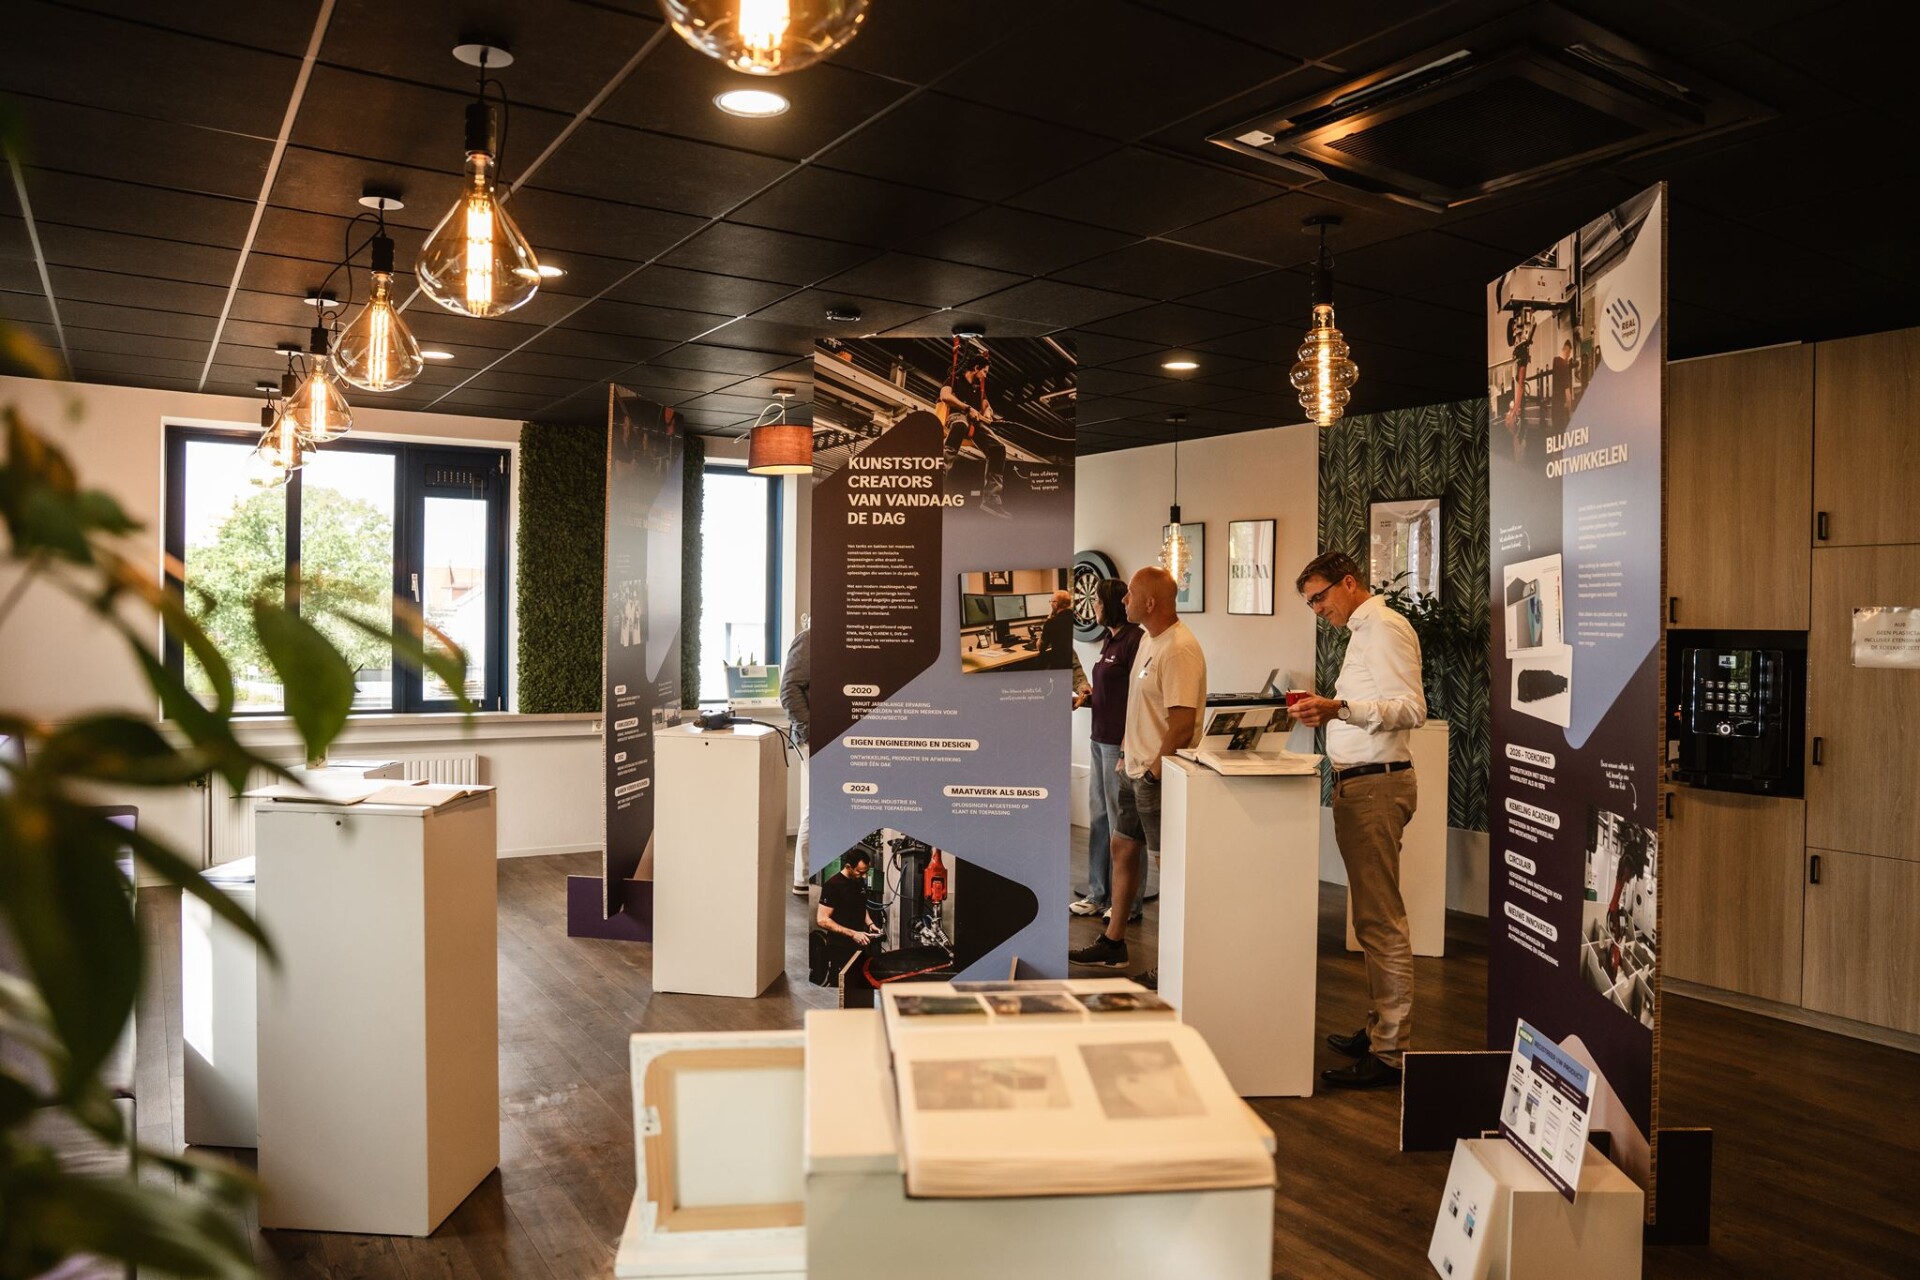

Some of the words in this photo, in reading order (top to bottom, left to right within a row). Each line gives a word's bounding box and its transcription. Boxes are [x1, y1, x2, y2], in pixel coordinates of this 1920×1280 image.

[1621, 318, 1636, 330] REAL
[1546, 426, 1589, 454] BLIJVEN
[848, 457, 944, 470] KUNSTSTOF
[1546, 443, 1628, 478] ONTWIKKELEN
[847, 475, 933, 488] CREATORS
[847, 493, 881, 507] VAN
[885, 494, 965, 507] VANDAAG
[847, 512, 868, 525] DE
[872, 512, 906, 525] DAG
[929, 740, 940, 748] EN
[1524, 751, 1551, 765] TOEKOMST
[1016, 789, 1040, 797] BASIS
[1509, 802, 1531, 816] KEMELING
[1532, 810, 1555, 824] ACADEMY
[1508, 854, 1532, 870] CIRCULAIR
[1508, 905, 1525, 922] NIEUWE
[1525, 916, 1553, 937] INNOVATIES
